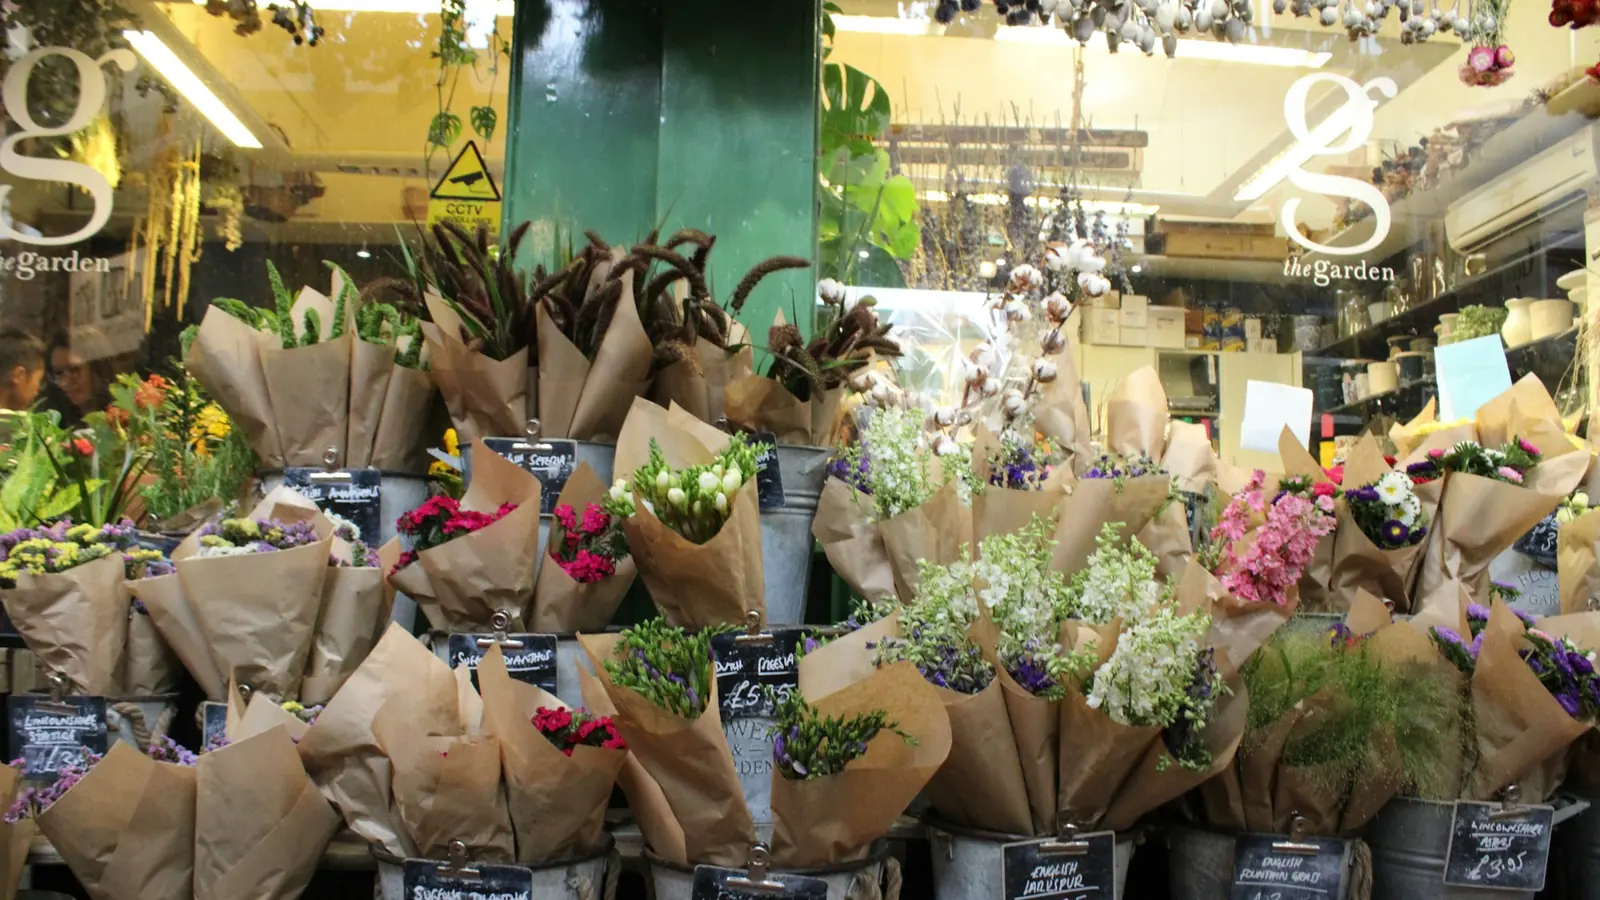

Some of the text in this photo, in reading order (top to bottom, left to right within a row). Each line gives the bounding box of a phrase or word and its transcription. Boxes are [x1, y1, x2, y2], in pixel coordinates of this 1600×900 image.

[446, 203, 483, 215] CCTV
[503, 649, 552, 666] DIANTHUS
[1030, 861, 1079, 879] ENGLISH
[1262, 857, 1303, 868] ENGLISH
[1465, 851, 1528, 880] £3.95
[1240, 868, 1321, 884] FOUNTAIN GRASS
[1023, 874, 1085, 896] LARKSPUR
